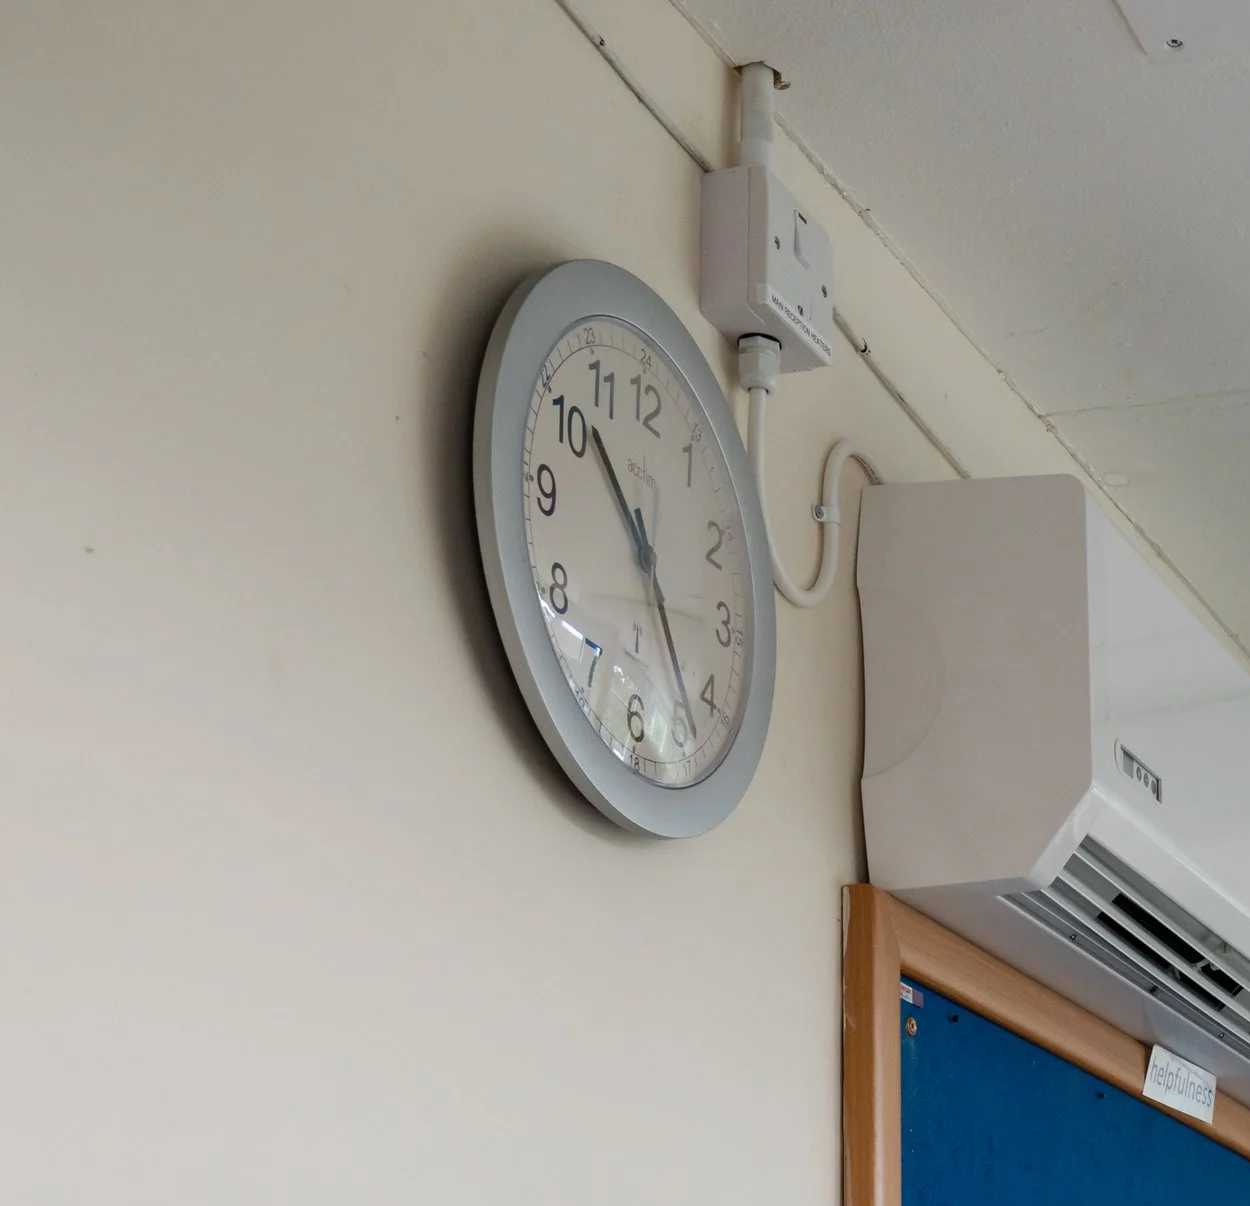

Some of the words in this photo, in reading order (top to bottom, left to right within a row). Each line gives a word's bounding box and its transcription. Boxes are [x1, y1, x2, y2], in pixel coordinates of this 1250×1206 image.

[583, 327, 596, 345] 23
[771, 294, 784, 311] MAIN
[784, 306, 811, 337] RECEPTION
[640, 348, 652, 368] 24
[588, 359, 615, 420] 11
[630, 373, 661, 439] 12
[552, 393, 587, 459] 10
[682, 442, 693, 488] 1
[536, 463, 557, 517] 9
[705, 519, 723, 571] 2
[549, 561, 569, 615] 8
[715, 600, 732, 648] 3
[584, 636, 603, 688] 7
[626, 693, 645, 743] 6
[700, 673, 717, 718] 4
[671, 699, 688, 748] 5
[629, 754, 640, 772] 18
[682, 760, 692, 777] 17
[1149, 1055, 1213, 1108] helpfulness
